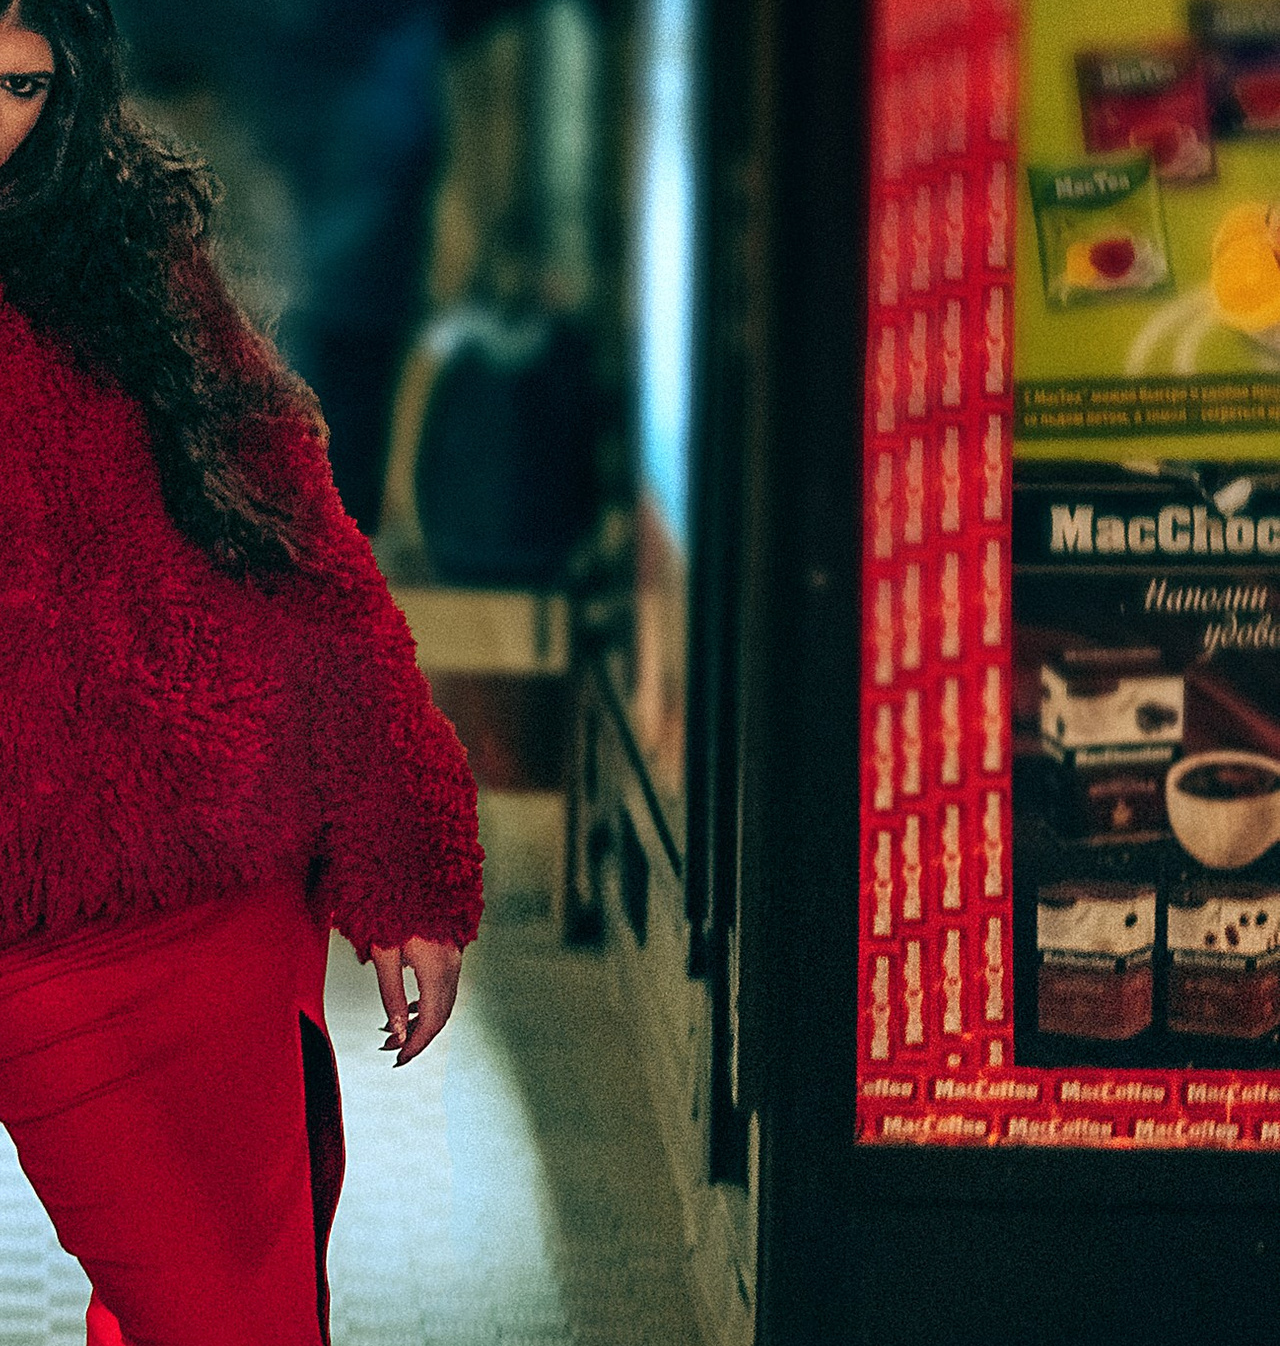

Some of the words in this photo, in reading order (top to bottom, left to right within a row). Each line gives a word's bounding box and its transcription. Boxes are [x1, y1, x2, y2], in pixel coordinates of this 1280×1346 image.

[1050, 504, 1280, 554] MacChoc
[935, 1078, 1038, 1100] MacCoffee
[1061, 1081, 1166, 1102] MacCoffee
[883, 1115, 988, 1136] MacCoffee
[1135, 1119, 1239, 1141] MacCoffee
